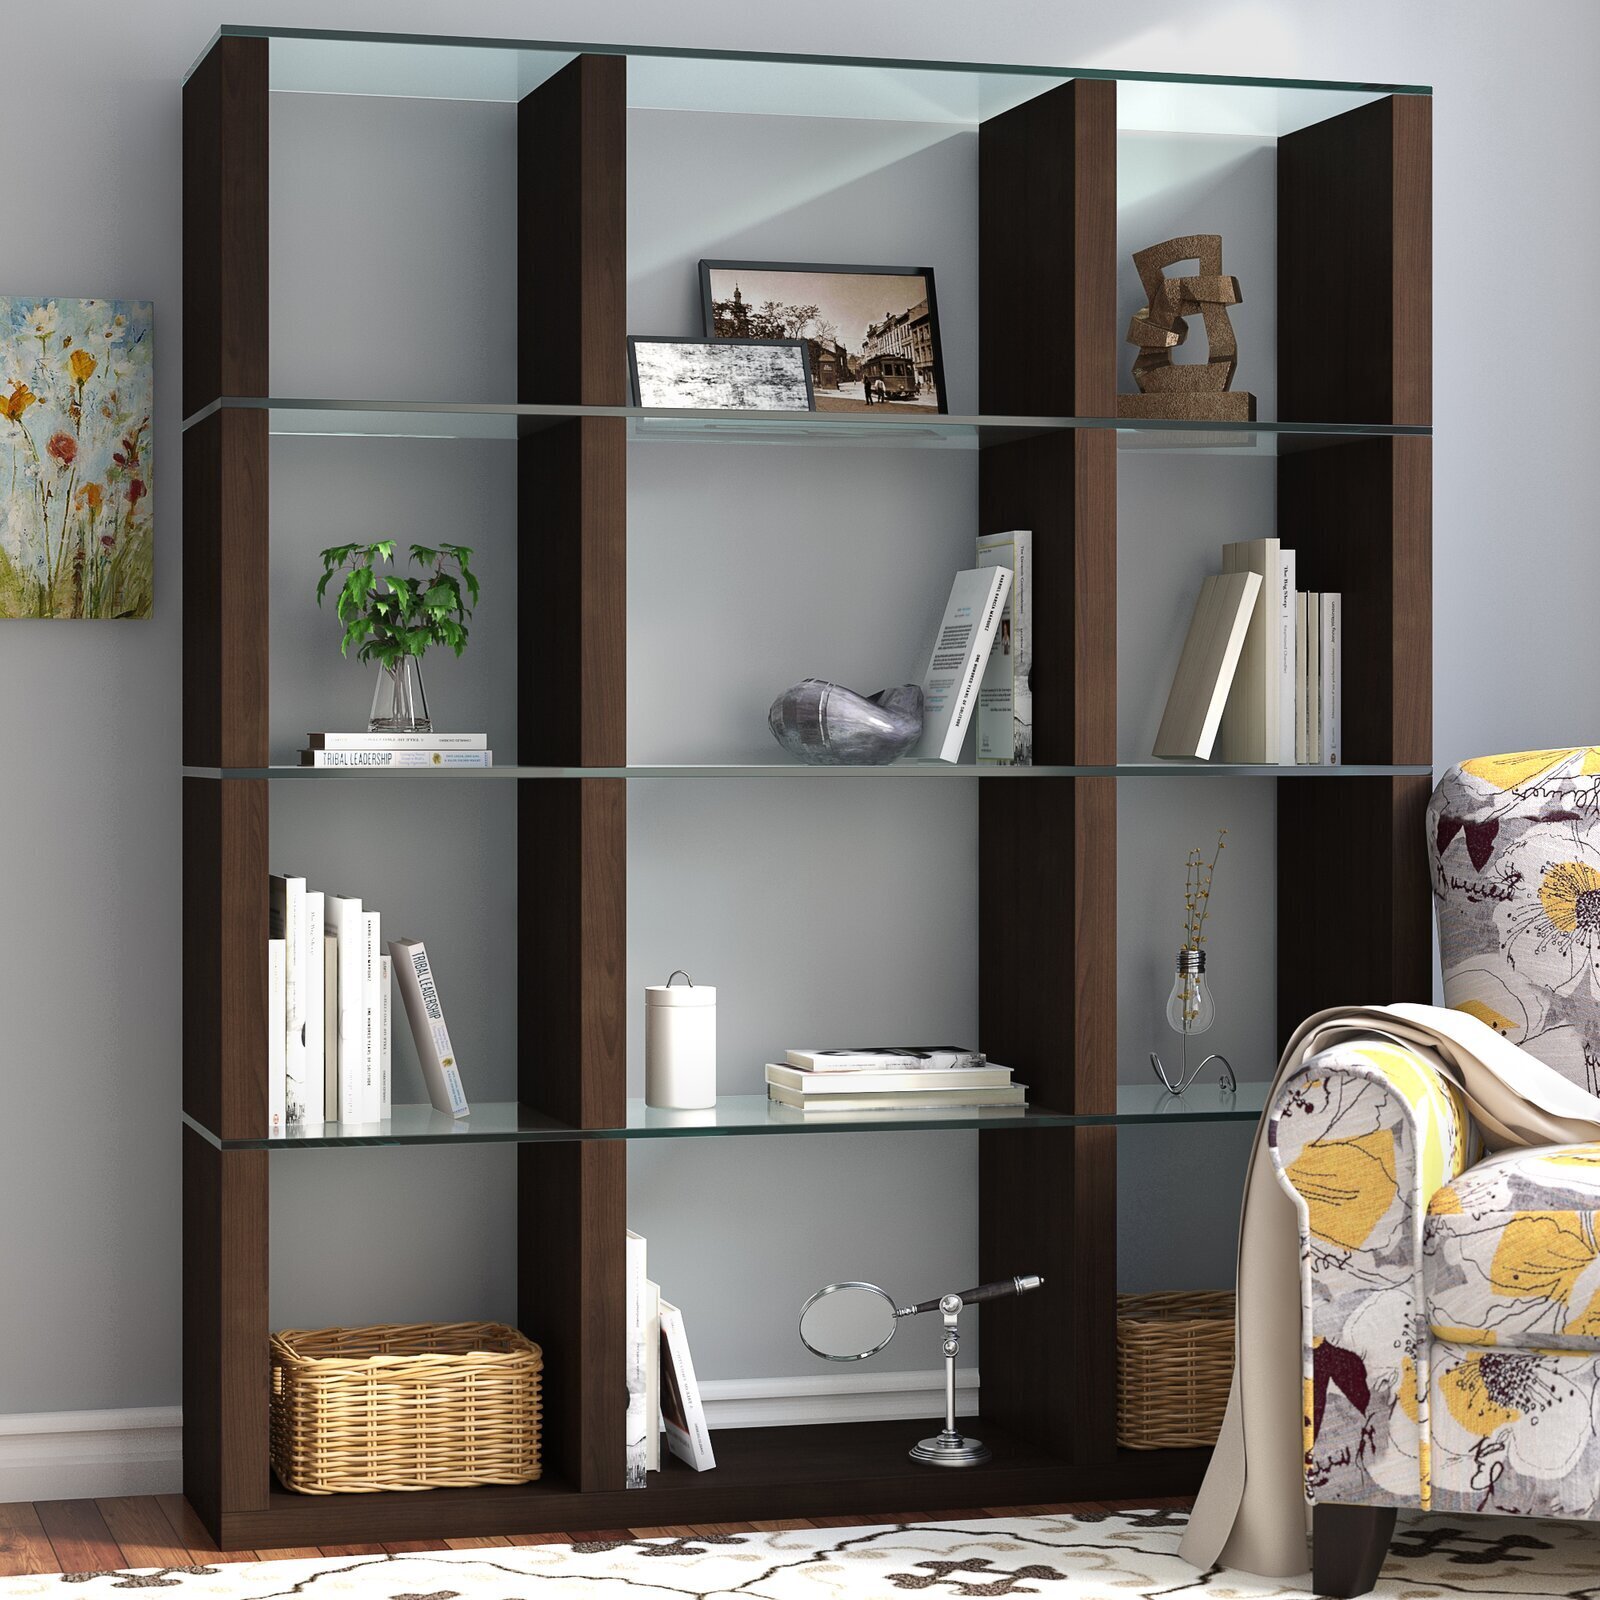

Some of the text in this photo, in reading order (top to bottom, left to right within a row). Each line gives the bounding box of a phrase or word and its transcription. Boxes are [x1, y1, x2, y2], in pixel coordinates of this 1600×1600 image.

[323, 752, 348, 766] TRIBAL
[350, 752, 392, 766] LEADERSHIP
[412, 950, 430, 979] TRIBAL
[418, 976, 442, 1020] LEADERSHIP
